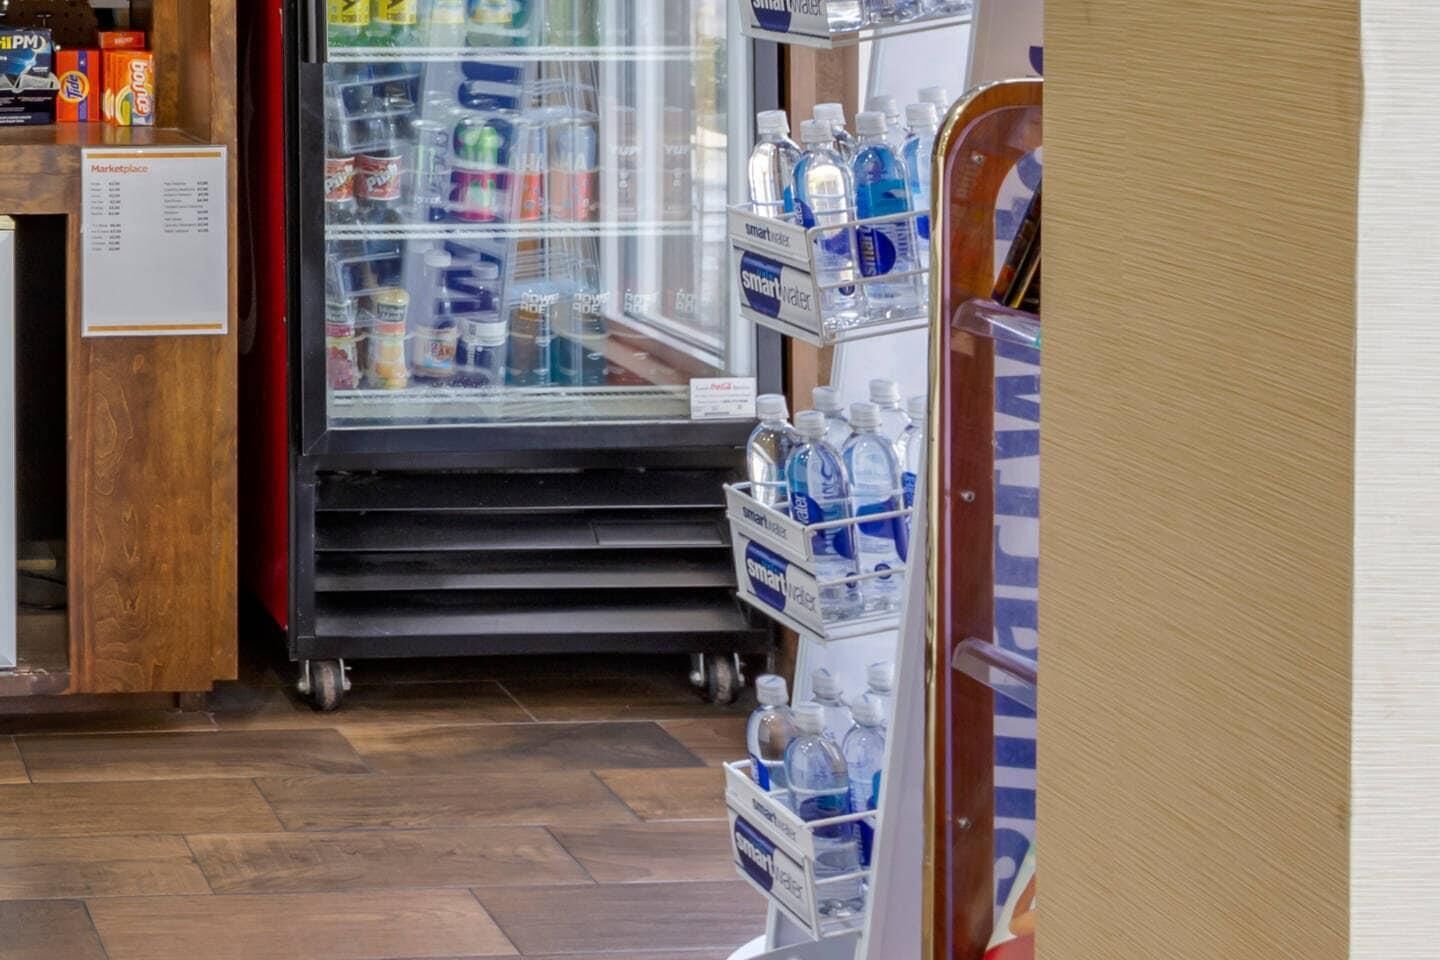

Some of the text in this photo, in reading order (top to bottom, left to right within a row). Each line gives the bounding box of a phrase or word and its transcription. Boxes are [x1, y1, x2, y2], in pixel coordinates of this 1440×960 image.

[12, 35, 38, 49] PM
[65, 73, 82, 100] Tide
[91, 164, 148, 174] Marketplace
